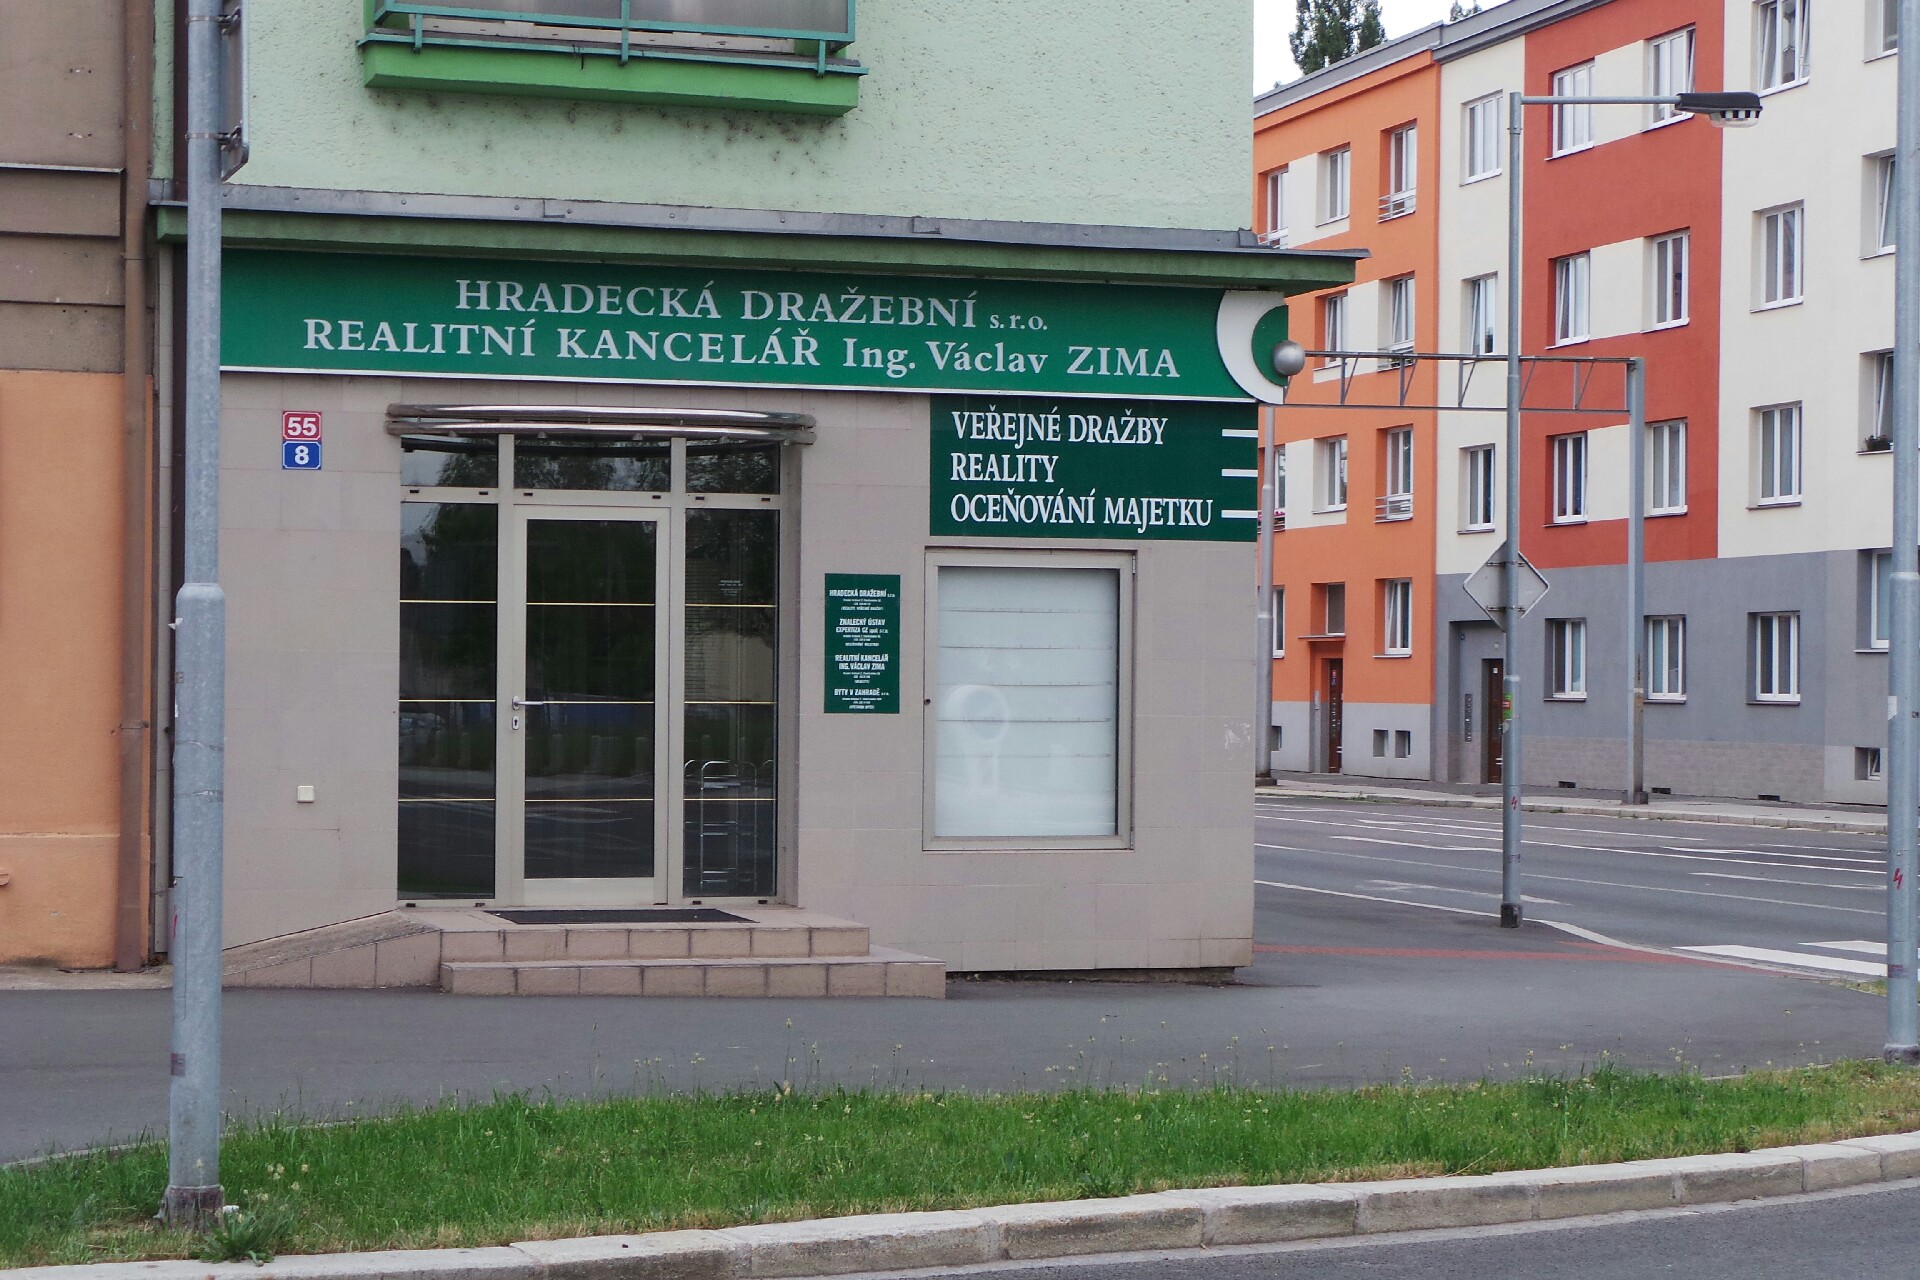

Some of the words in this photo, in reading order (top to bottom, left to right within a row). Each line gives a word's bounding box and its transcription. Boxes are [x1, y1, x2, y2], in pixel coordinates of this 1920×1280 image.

[455, 280, 722, 318] HRADECKÁ
[740, 287, 978, 328] DRAŽEBNÍ
[989, 314, 1048, 331] s.r.o.
[303, 318, 536, 357] REALITNÍ
[556, 328, 820, 366] KANCELÁŘ
[843, 337, 916, 379] Ing.
[926, 341, 1048, 375] Václav
[1067, 346, 1181, 378] ZIMA
[287, 416, 317, 436] 55
[951, 405, 1061, 450] VEŘEJNÉ
[1067, 408, 1169, 446] DRAŽBY
[294, 445, 309, 465] 8
[951, 452, 1059, 483] REALITY
[951, 487, 1096, 525] OCEŇOVÁNÍ
[1103, 498, 1214, 534] MAJETKU
